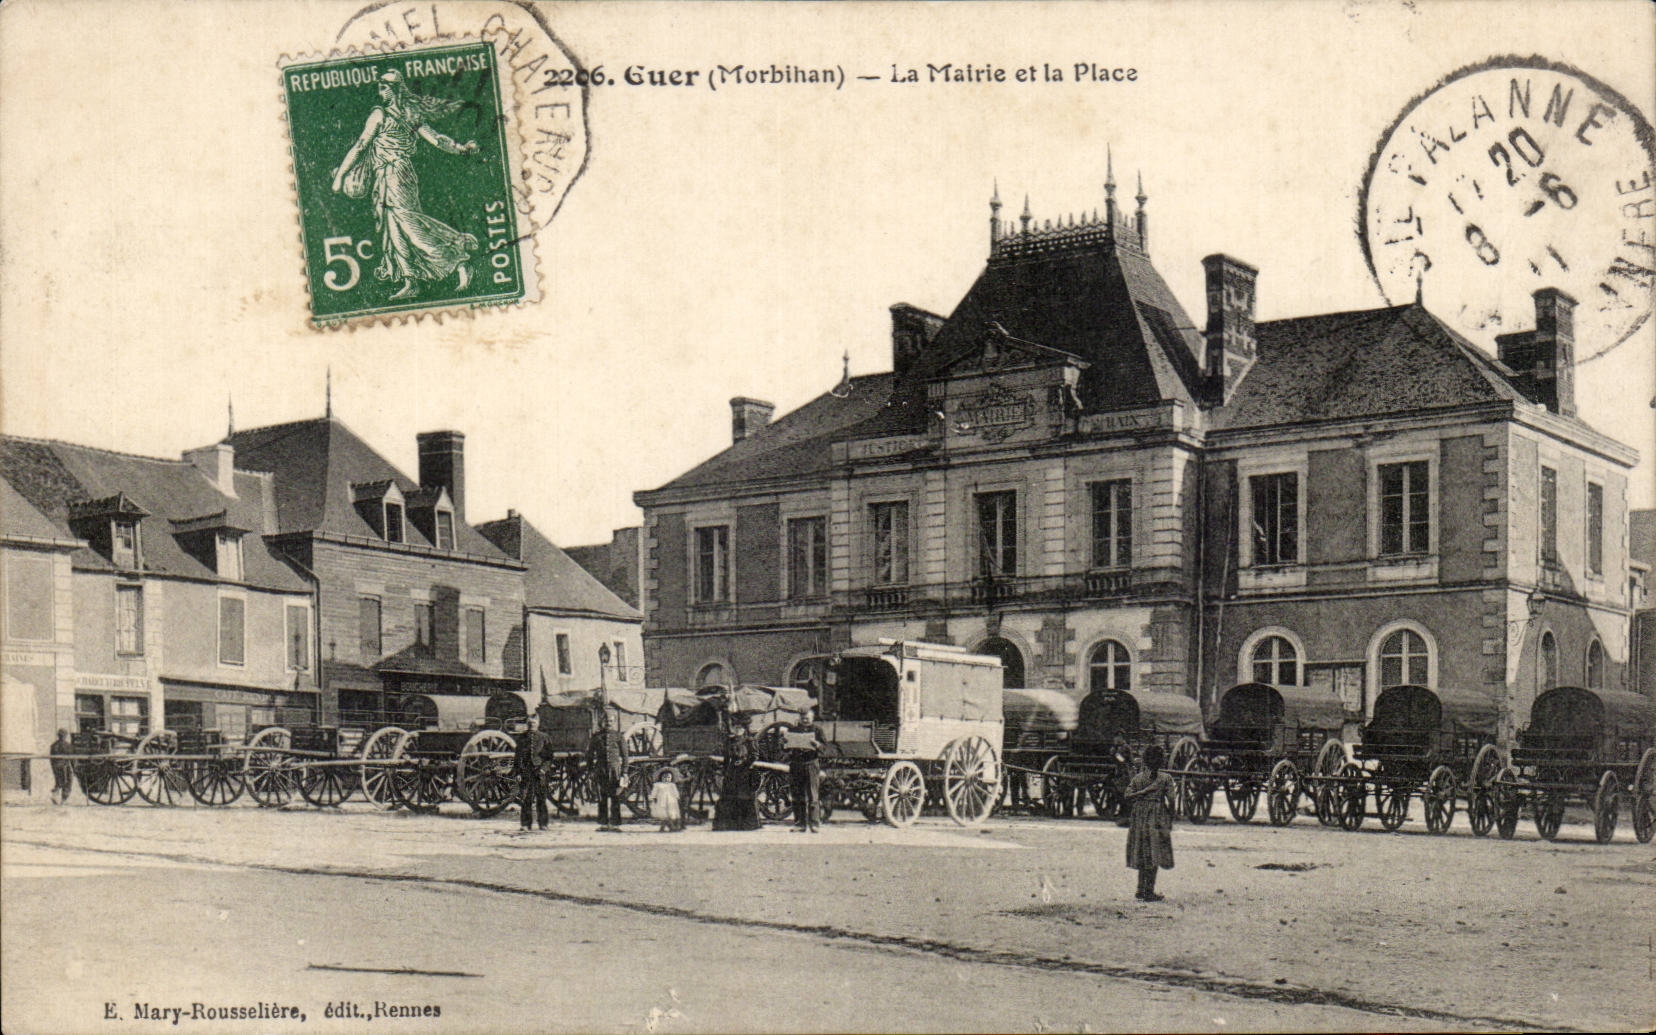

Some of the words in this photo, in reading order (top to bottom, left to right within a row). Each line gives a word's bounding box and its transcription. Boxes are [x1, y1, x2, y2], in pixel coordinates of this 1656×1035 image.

[290, 65, 379, 93] REPUBLIQUE
[405, 52, 488, 78] FRANÇAISE
[485, 200, 511, 284] POSTES
